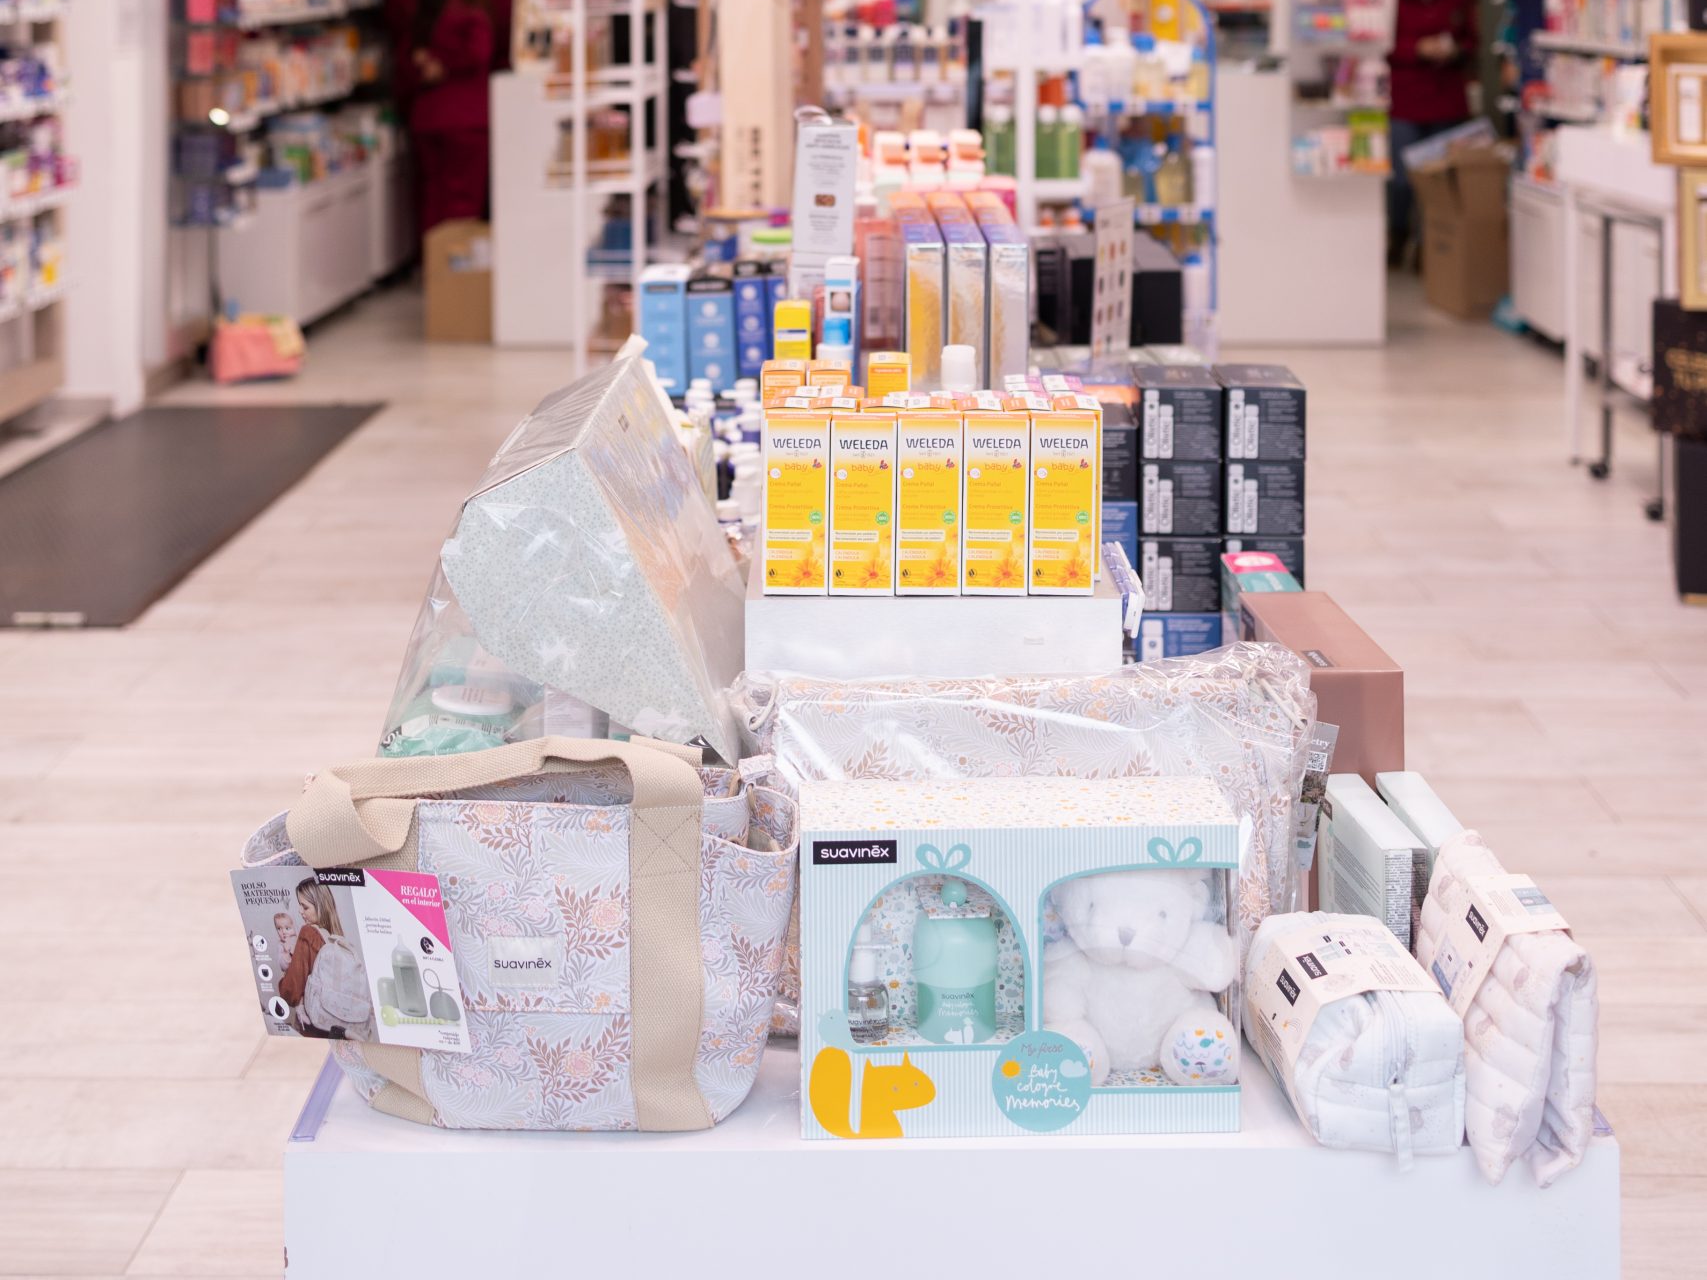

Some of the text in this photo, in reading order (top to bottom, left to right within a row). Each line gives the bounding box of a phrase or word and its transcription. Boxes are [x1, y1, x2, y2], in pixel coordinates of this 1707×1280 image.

[773, 438, 821, 449] WELEDA
[840, 440, 888, 450] WELEDA
[906, 438, 954, 449] WELEDA
[973, 438, 1021, 449] WELEDA
[1040, 438, 1088, 449] WELEDA
[784, 463, 808, 472] baby
[851, 464, 875, 474] baby
[918, 463, 941, 472] baby
[984, 463, 1008, 472] baby
[1052, 463, 1075, 472] baby
[241, 882, 266, 891] BOLSO
[243, 888, 290, 898] MATERNIDAD
[245, 895, 280, 906] PEQUEÑO
[410, 898, 416, 906] el
[417, 899, 440, 908] interior
[1028, 1064, 1058, 1083] Baby
[1017, 1077, 1068, 1096] cologne
[1006, 1095, 1080, 1112] Memories
